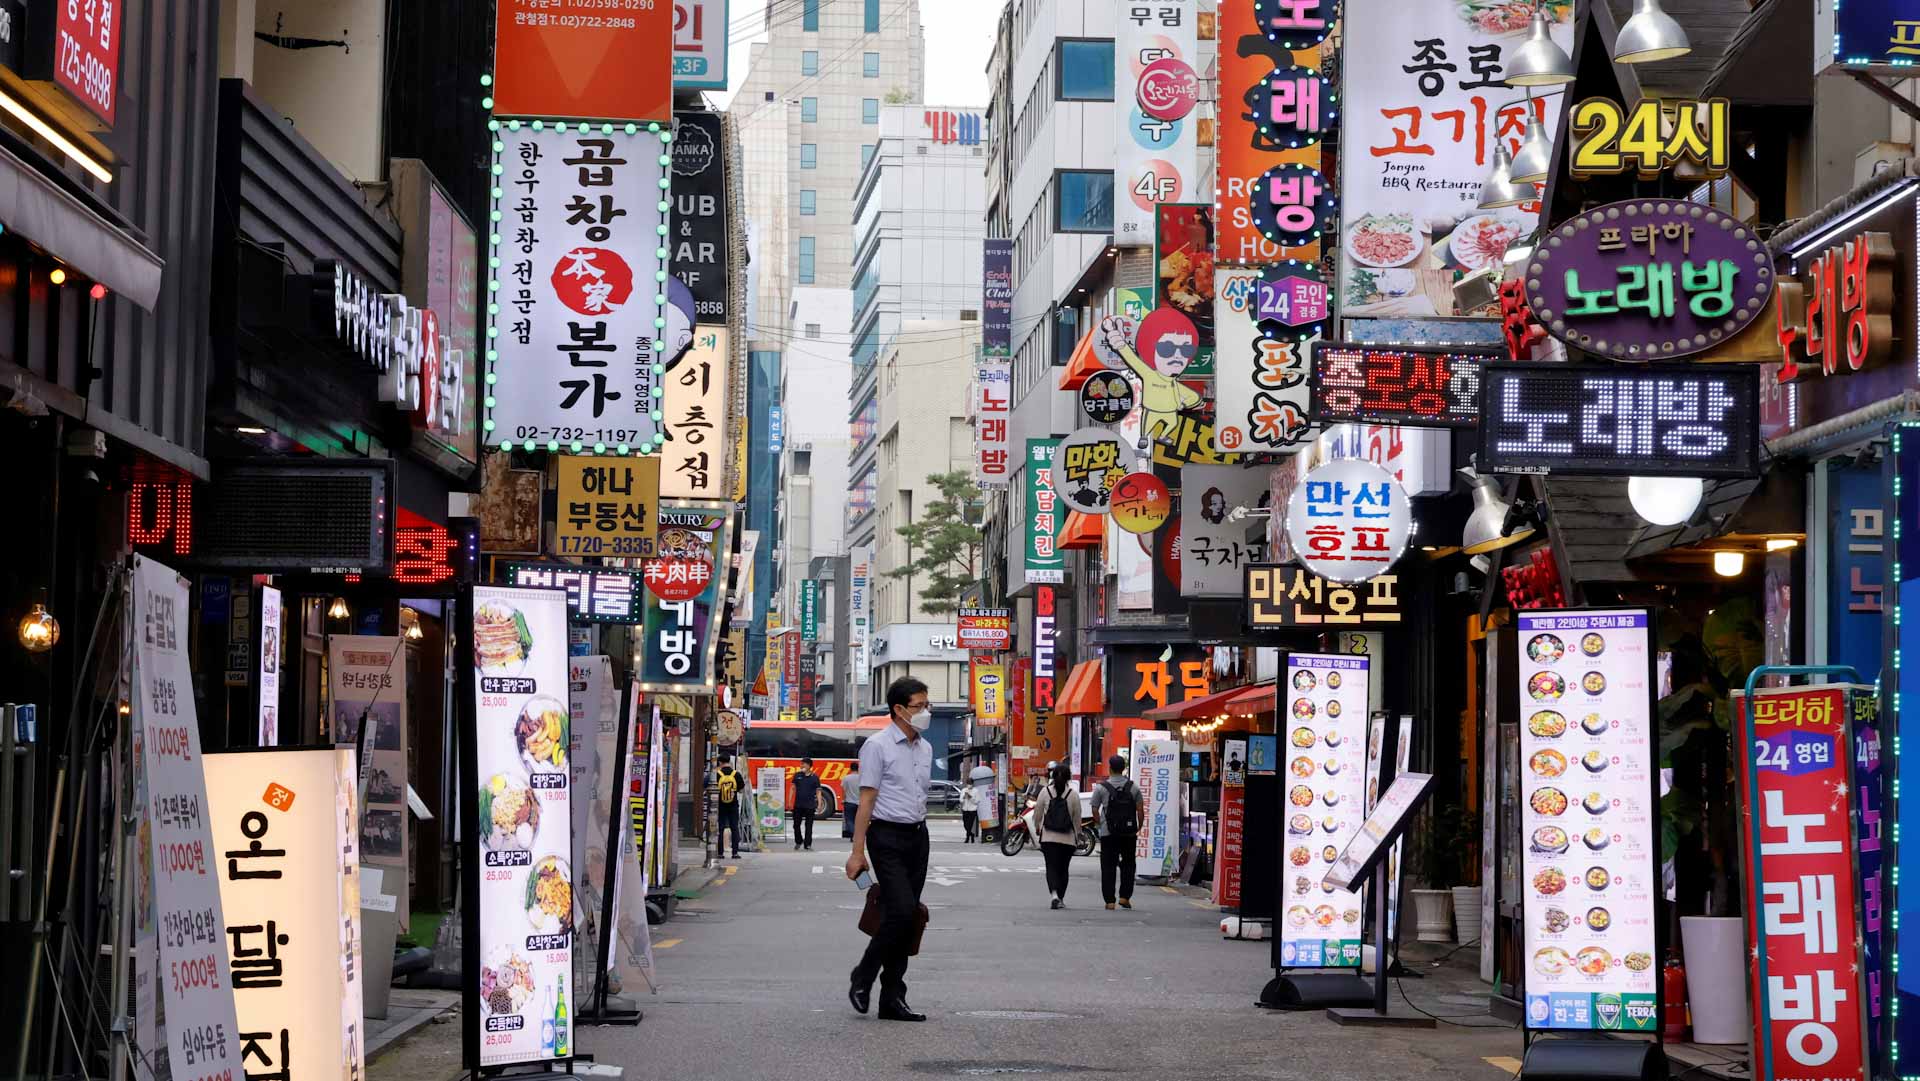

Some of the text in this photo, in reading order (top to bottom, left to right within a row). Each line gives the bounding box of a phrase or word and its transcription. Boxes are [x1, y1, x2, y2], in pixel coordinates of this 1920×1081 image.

[1130, 8, 1181, 27] 무림
[61, 30, 112, 111] 725-9998
[1403, 38, 1514, 97] 종로
[1574, 98, 1729, 170] 24시
[1382, 161, 1425, 174] Jongno
[562, 139, 628, 242] 곱창
[1135, 171, 1176, 201] 4F
[1382, 177, 1411, 190] BBQ
[1598, 221, 1694, 256] 프라하
[562, 250, 626, 313] 本家
[986, 289, 1012, 298] Club
[1294, 284, 1323, 303] 코인
[1562, 259, 1741, 318] 노래방
[1260, 286, 1290, 318] 24
[556, 321, 622, 419] 본가
[634, 337, 651, 413] 종로직영점
[1084, 398, 1132, 413] 당구클럽
[1104, 413, 1116, 422] 4F
[1497, 378, 1735, 456] 노래방
[516, 426, 639, 443] 02-732-1197
[674, 362, 714, 490] 이층집
[981, 388, 1009, 475] 노래방
[1223, 432, 1240, 446] B1
[1066, 442, 1118, 482] 만화
[582, 467, 634, 496] 하나
[1306, 481, 1391, 518] 만선
[568, 503, 647, 531] 부동산
[657, 513, 705, 527] UXURY
[560, 536, 653, 555] T.720-3335
[1305, 525, 1391, 562] 호프
[644, 561, 710, 584] 羊肉串
[1249, 567, 1402, 625] 만선호프
[1557, 618, 1588, 628] 2인이상
[1590, 617, 1615, 628] 주문시
[1617, 616, 1635, 627] 제공
[1035, 586, 1055, 708] BEER
[483, 677, 533, 693] 한우 곱창구이
[482, 696, 508, 707] 25,000
[1754, 696, 1834, 726] 프라하
[1755, 740, 1830, 771] 24 영업
[531, 775, 565, 789] 대창구이
[544, 790, 567, 801] 19,000
[154, 793, 200, 830] 치즈떡볶이
[159, 839, 206, 882] 11,000원
[486, 870, 513, 881] 25,000
[163, 907, 217, 948] 간장마요밥
[1760, 790, 1847, 1067] 노래방
[546, 953, 568, 963] 15,000
[170, 953, 220, 1000] 5,000원
[1625, 1006, 1656, 1018] TERRA
[486, 1034, 513, 1045] 25,000
